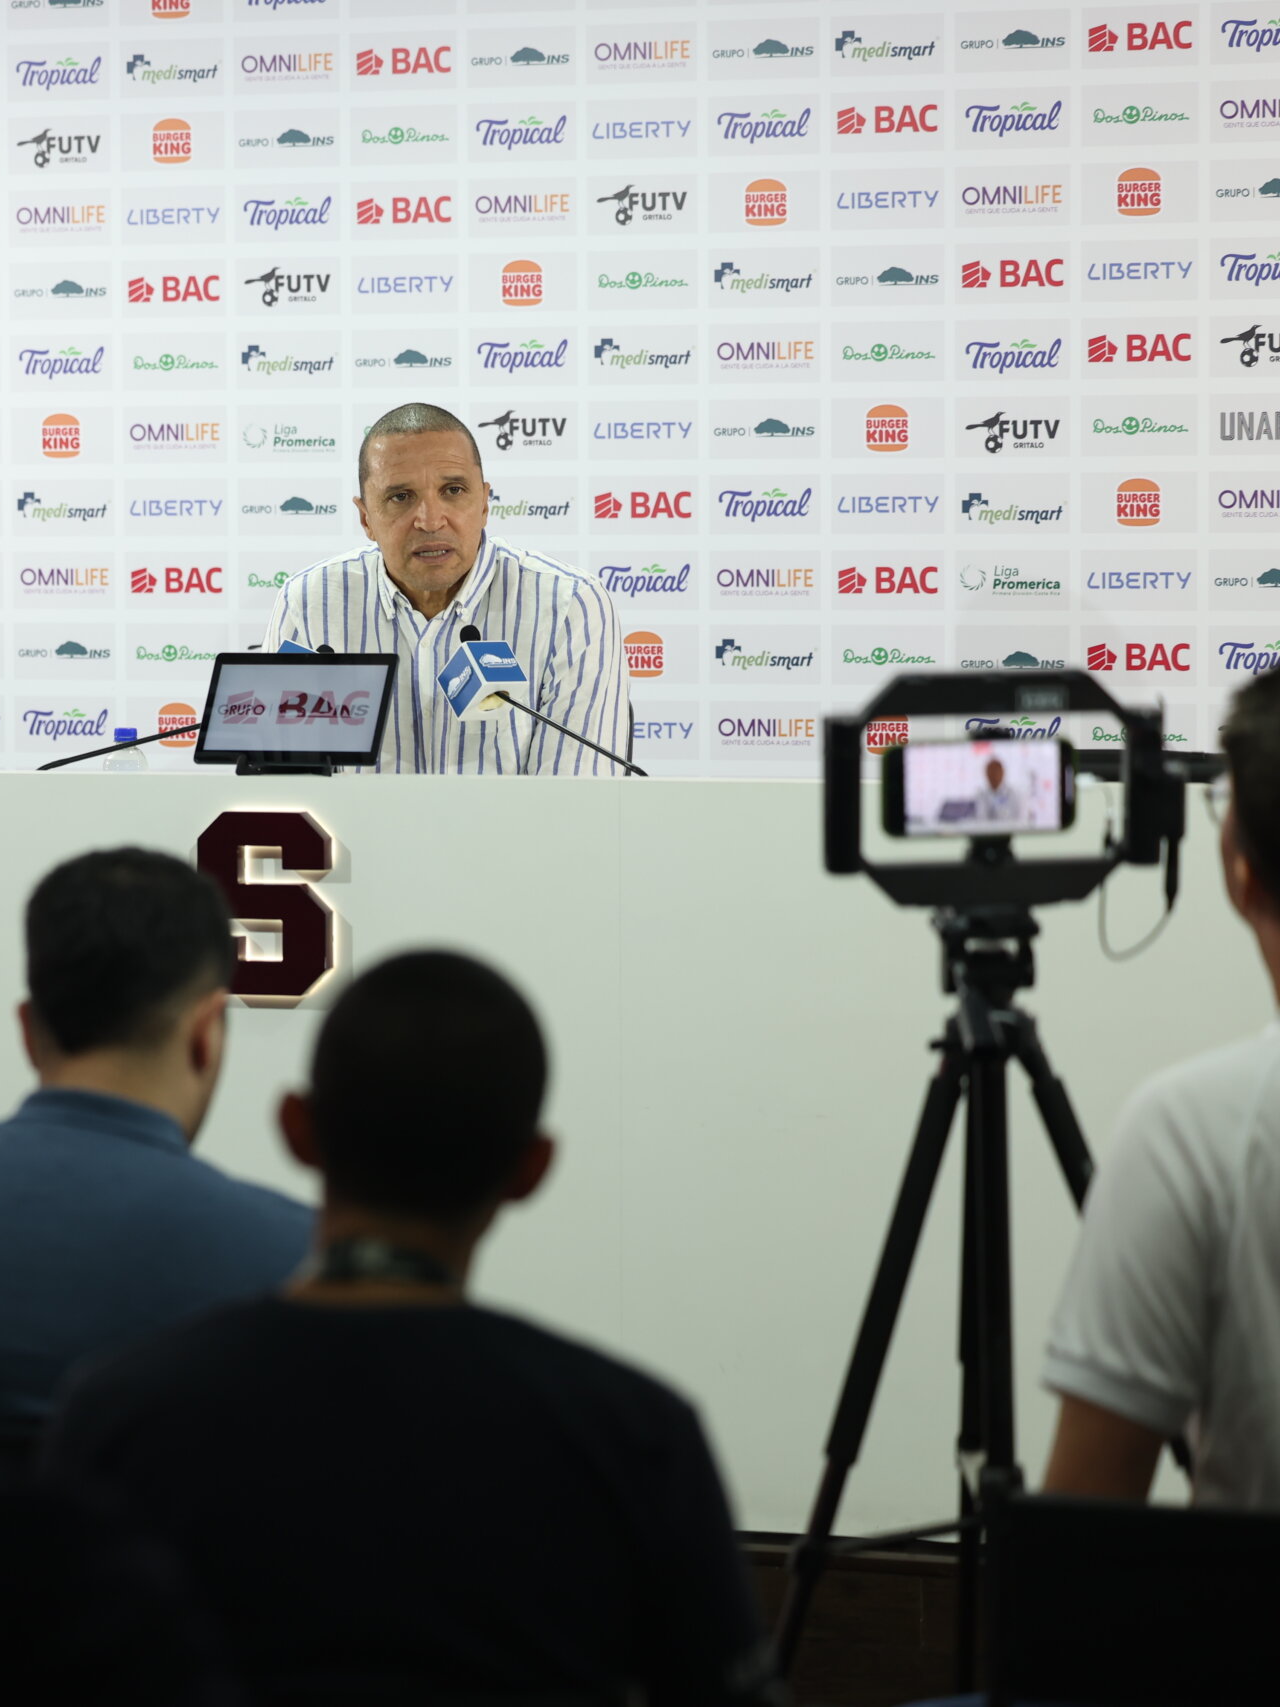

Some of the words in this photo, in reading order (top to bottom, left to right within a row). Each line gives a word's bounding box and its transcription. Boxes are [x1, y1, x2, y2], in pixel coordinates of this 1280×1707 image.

[1127, 21, 1192, 50] BAC
[392, 46, 451, 74] BAC
[471, 57, 502, 66] GRUPO
[546, 54, 569, 65] INS
[712, 49, 744, 58] GRUPO
[788, 46, 813, 57] INS
[852, 41, 935, 62] medismart
[241, 53, 333, 73] OMNILIFE
[142, 65, 218, 84] medismart
[1093, 109, 1122, 123] Dos
[1139, 106, 1189, 121] Pinos
[476, 115, 567, 150] Tropical
[592, 120, 691, 139] LIBERTY
[717, 108, 811, 144] Tropical
[46, 135, 100, 154] FUTV
[362, 129, 388, 144] Dos
[403, 128, 449, 142] Pinos
[475, 194, 569, 214] OMNILIFE
[628, 191, 687, 211] FUTV
[746, 194, 787, 202] BURGER
[837, 191, 939, 209] LIBERTY
[962, 185, 1062, 205] OMNILIFE
[16, 205, 105, 225] OMNILIFE
[127, 208, 220, 225] LIBERTY
[746, 204, 787, 216] KING
[503, 275, 542, 283] BURGER
[836, 276, 869, 285] GRUPO
[913, 275, 939, 285] INS
[1000, 259, 1064, 287] BAC
[14, 289, 44, 297] GRUPO
[84, 288, 106, 297] INS
[163, 275, 220, 302] BAC
[503, 284, 542, 296] KING
[477, 339, 568, 373] Tropical
[966, 338, 1061, 374] Tropical
[1127, 333, 1191, 362] BAC
[133, 356, 160, 370] Dos
[173, 355, 218, 369] Pinos
[355, 358, 386, 367] GRUPO
[429, 357, 451, 367] INS
[611, 350, 691, 368] medismart
[42, 428, 80, 436] BURGER
[130, 423, 220, 441] OMNILIFE
[274, 424, 297, 438] Liga
[509, 418, 566, 437] FUTV
[594, 422, 692, 439] LIBERTY
[714, 428, 745, 436] GRUPO
[789, 427, 814, 437] INS
[867, 420, 908, 428] BURGER
[999, 420, 1060, 439] FUTV
[1093, 419, 1122, 434] Dos
[1139, 418, 1188, 432] Pinos
[42, 437, 80, 448] KING
[274, 436, 335, 447] Promerica
[867, 429, 908, 442] KING
[631, 491, 691, 518] BAC
[719, 488, 811, 522] Tropical
[838, 496, 939, 513] LIBERTY
[1117, 494, 1160, 503] BURGER
[130, 500, 222, 516] LIBERTY
[242, 505, 272, 514] GRUPO
[315, 505, 336, 514] INS
[491, 501, 570, 519] medismart
[979, 505, 1063, 524] medismart
[1117, 504, 1160, 516] KING
[165, 567, 222, 593] BAC
[599, 564, 690, 597] Tropical
[717, 569, 813, 587] OMNILIFE
[994, 566, 1019, 579] Liga
[1087, 572, 1191, 589] LIBERTY
[993, 578, 1060, 589] Promerica
[18, 649, 47, 657] GRUPO
[87, 649, 110, 659] INS
[732, 651, 813, 670] medismart
[843, 649, 871, 664] Dos
[887, 648, 935, 663] Pinos
[1126, 643, 1190, 671] BAC
[217, 704, 266, 716] GRUPO
[275, 690, 370, 726] BAC
[23, 709, 108, 741] Tropical
[718, 718, 814, 737] OMNILIFE
[197, 811, 333, 996] S
